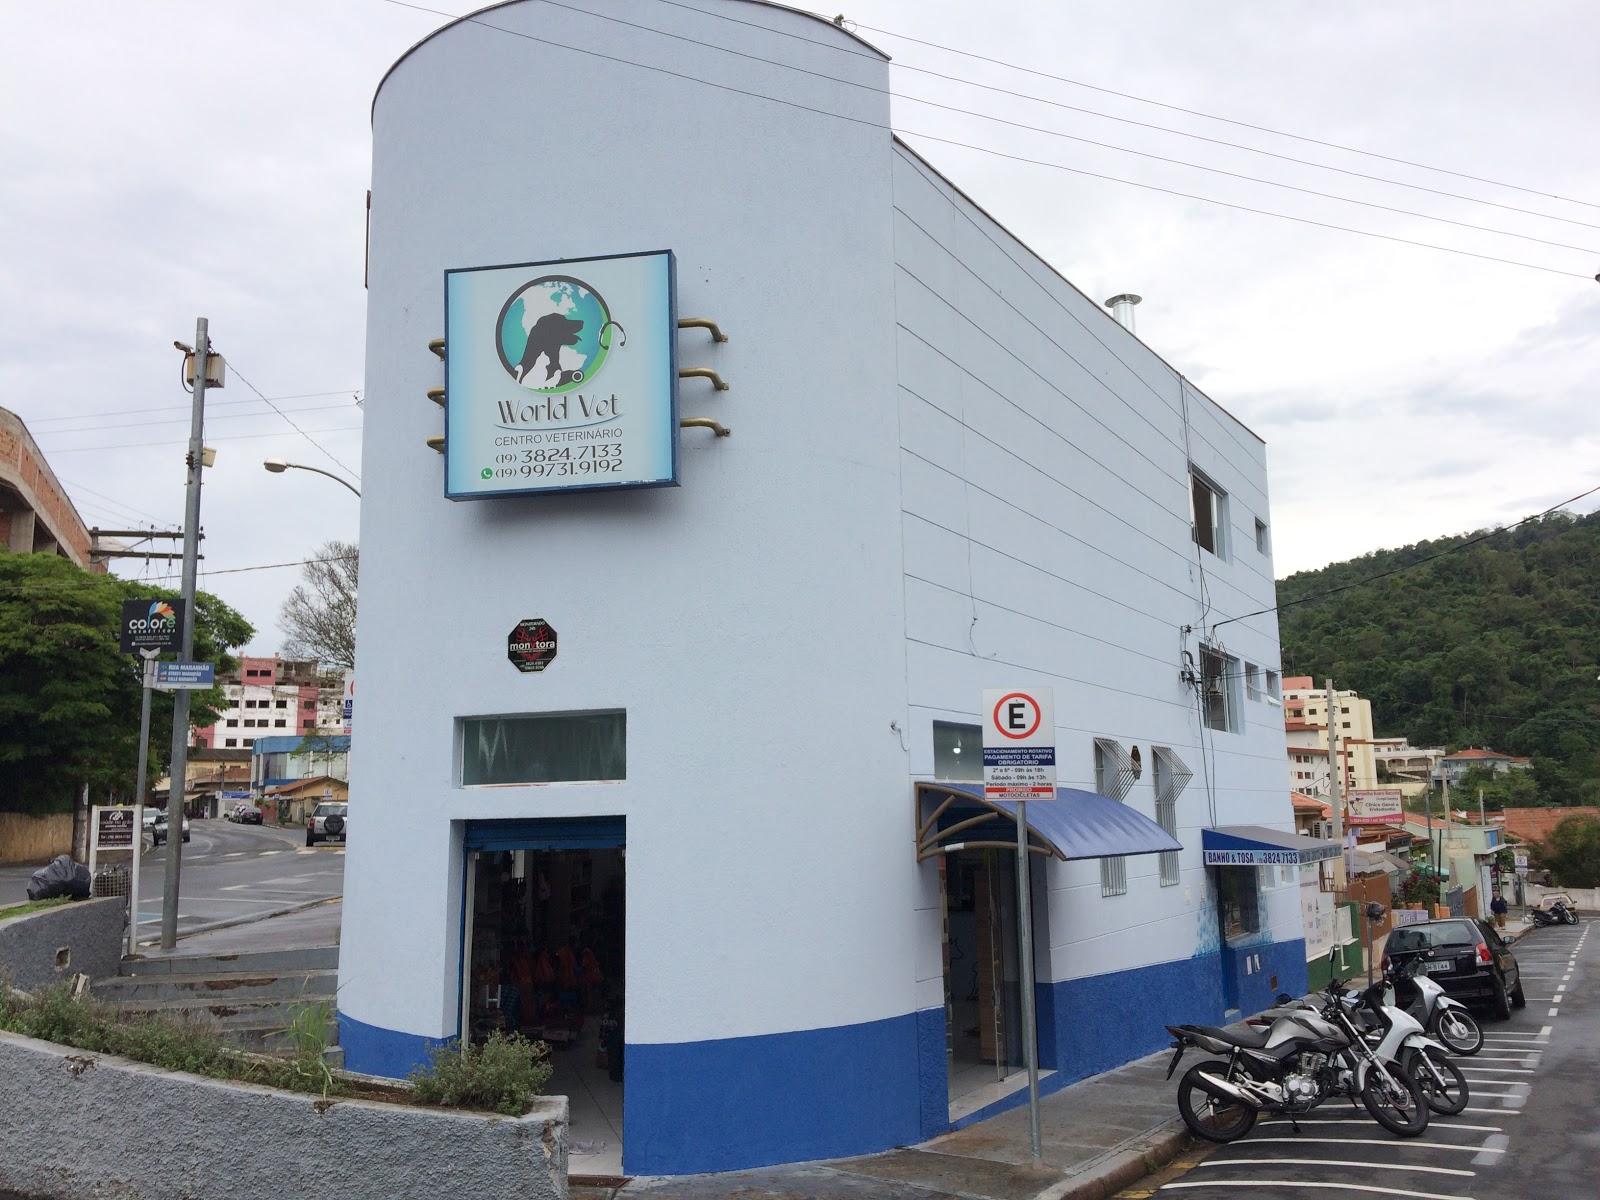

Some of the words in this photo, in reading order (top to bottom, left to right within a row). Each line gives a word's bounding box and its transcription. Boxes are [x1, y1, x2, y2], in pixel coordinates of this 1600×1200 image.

[497, 395, 567, 424] World
[578, 393, 618, 417] Vet
[495, 434, 542, 446] CENTRO
[545, 428, 623, 442] VETERINÁRIO
[495, 454, 517, 464] (19)
[521, 443, 622, 463] 3824.7133
[495, 468, 517, 478] (19)
[520, 459, 623, 478] 99731.9192
[1009, 703, 1026, 729] E
[1208, 852, 1230, 863] BANHO
[1231, 853, 1237, 863] &
[1237, 852, 1254, 863] TOSA
[1263, 852, 1298, 864] 3824.7133
